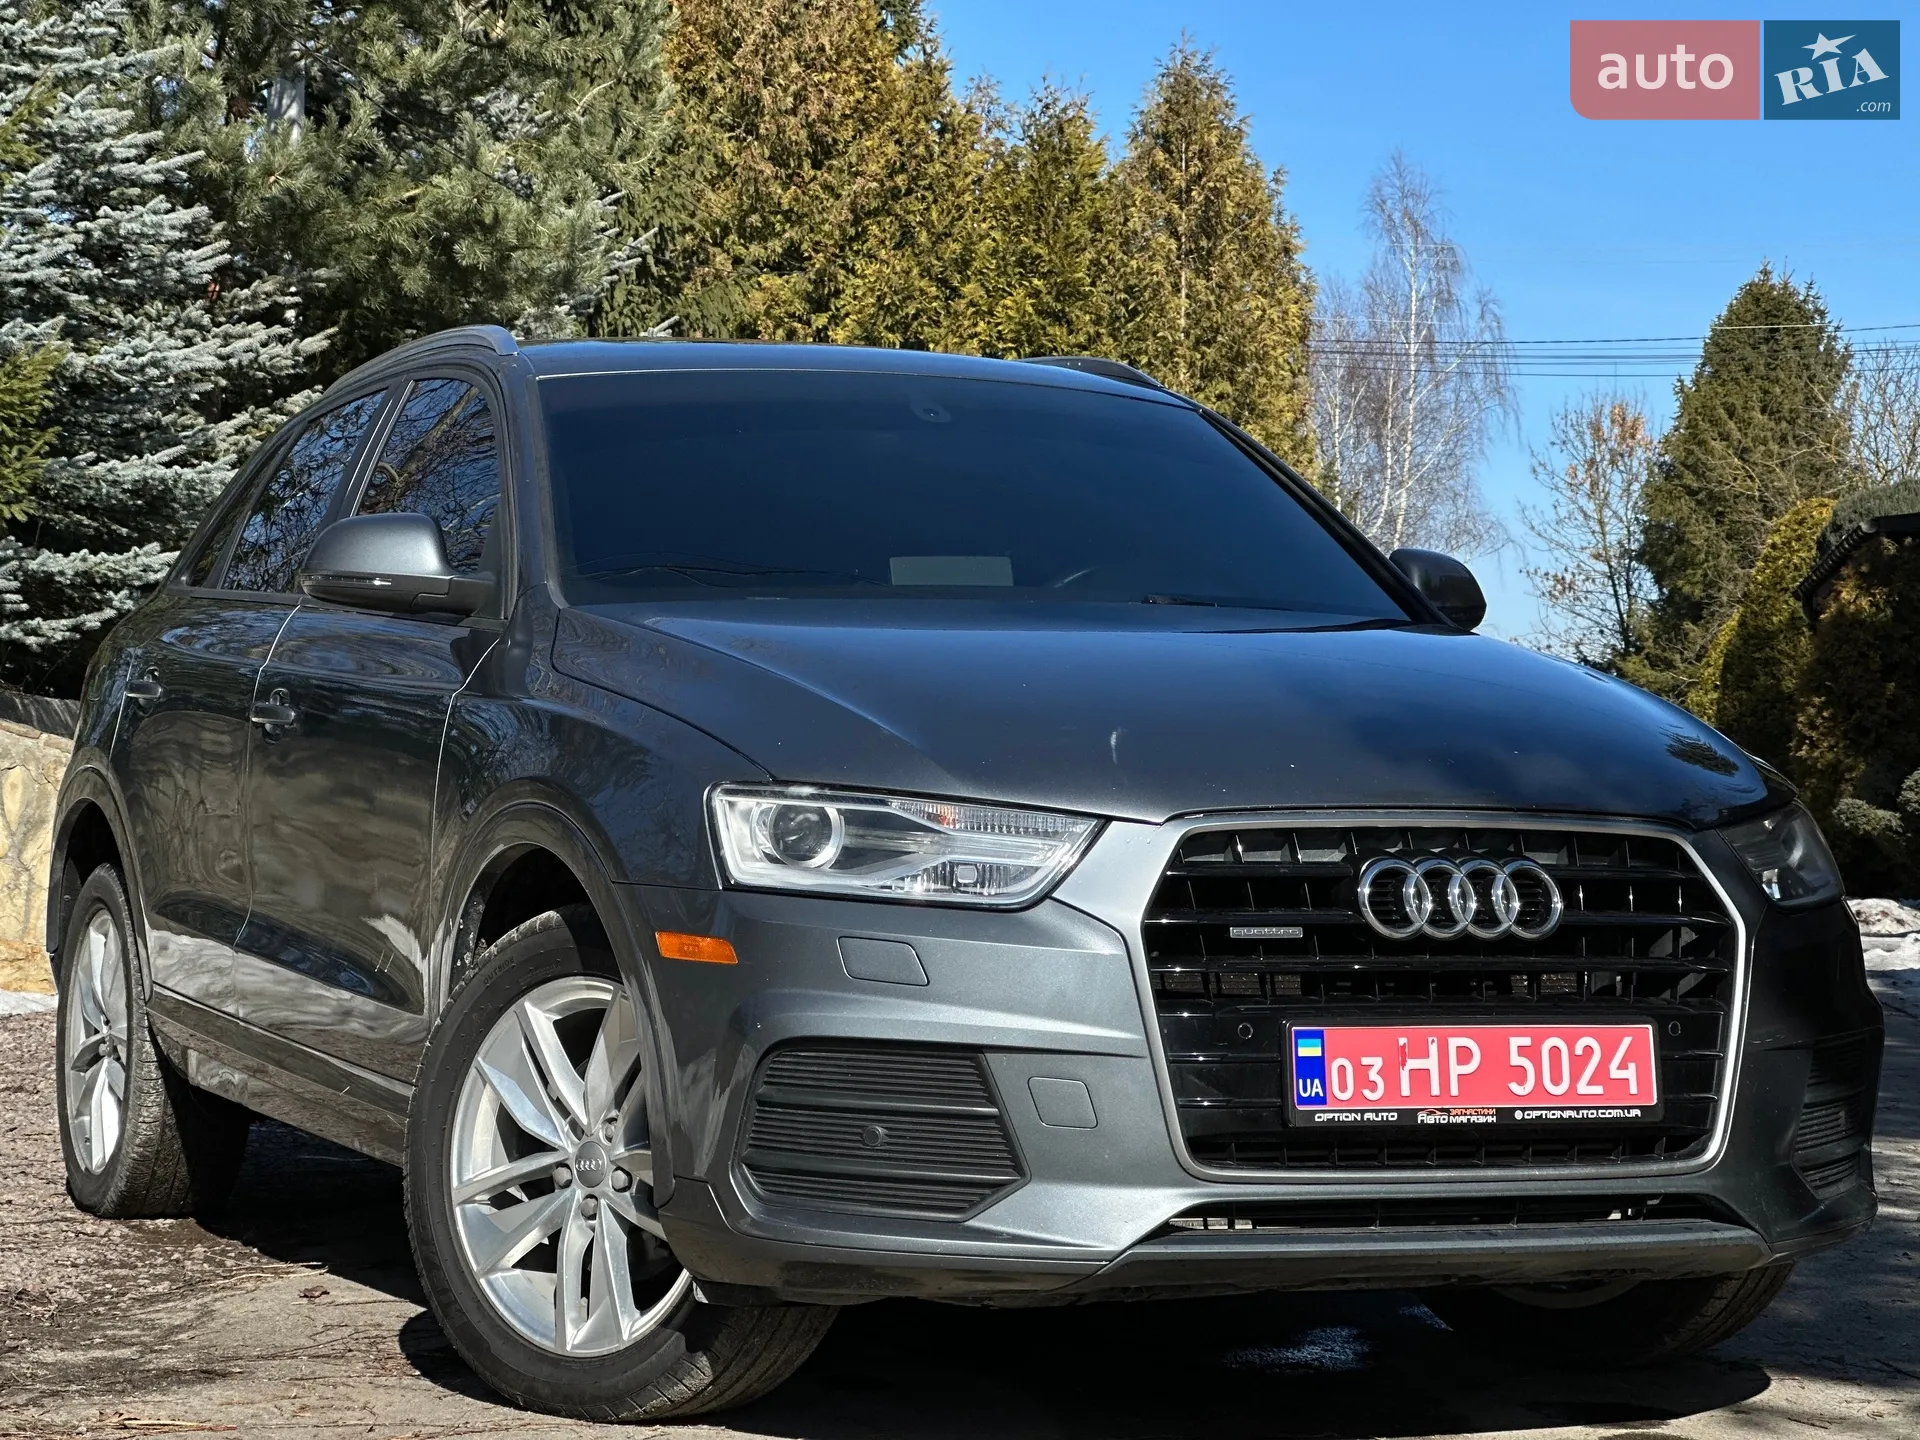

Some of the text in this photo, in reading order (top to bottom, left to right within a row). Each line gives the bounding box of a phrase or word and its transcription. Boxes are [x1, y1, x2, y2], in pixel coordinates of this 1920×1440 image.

[1299, 1036, 1638, 1101] UA 03 HP 5024
[1364, 1112, 1398, 1121] AUTO
